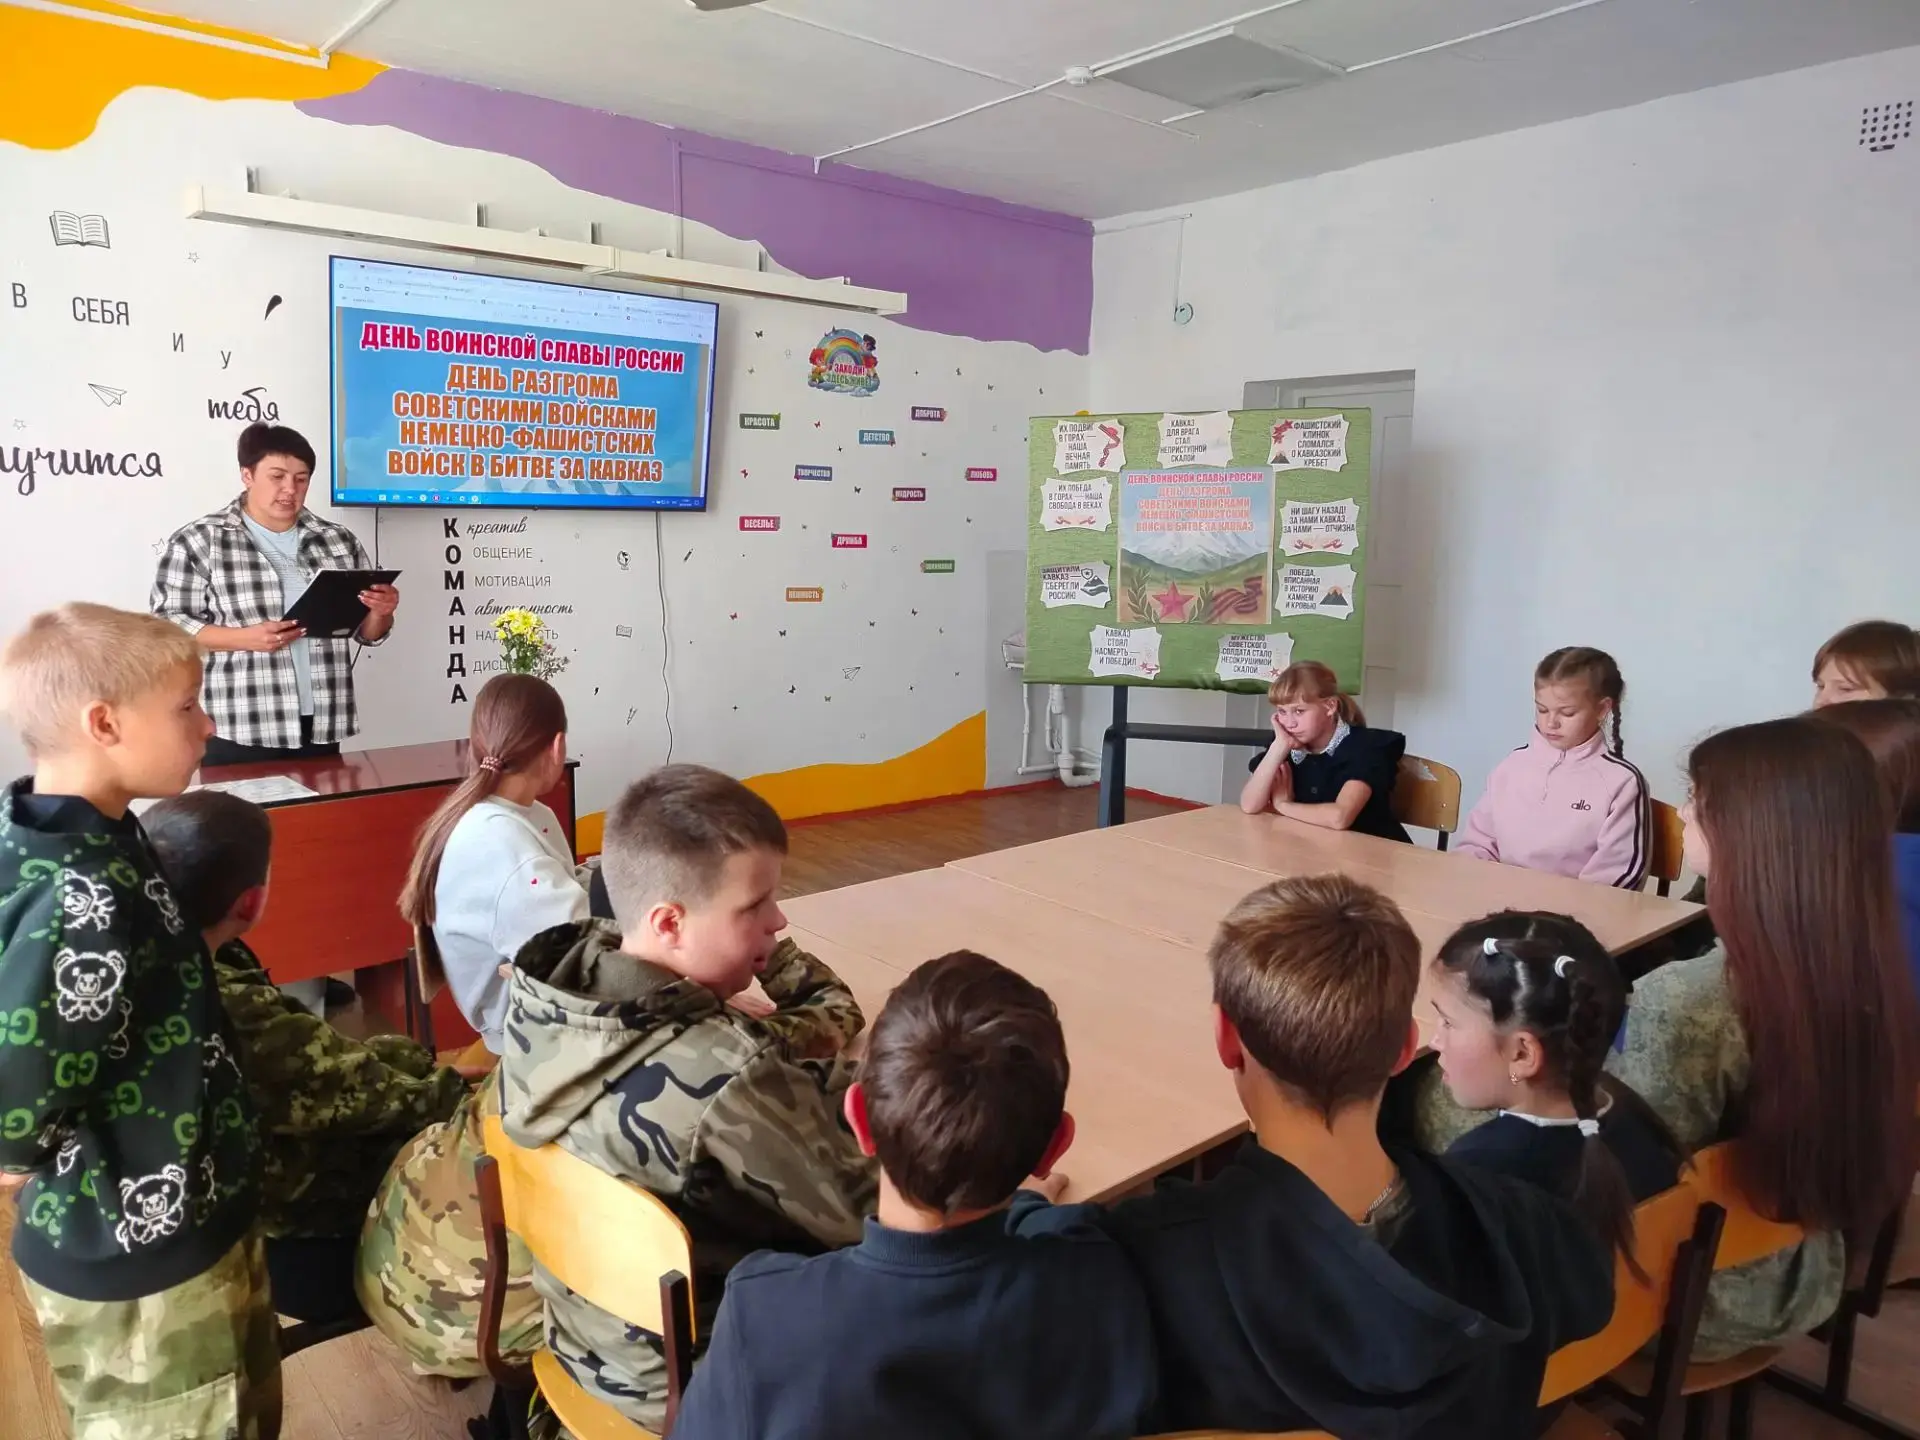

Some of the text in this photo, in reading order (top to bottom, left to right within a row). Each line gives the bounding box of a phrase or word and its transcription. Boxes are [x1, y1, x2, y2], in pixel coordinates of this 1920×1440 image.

[12, 282, 27, 308] В
[72, 297, 130, 326] СЕБЯ
[173, 332, 184, 352] И
[361, 322, 684, 373] ДЕНЬ ВОИНСКОЙ СЛАВЫ РОССИИ
[446, 363, 619, 399] ДЕНЬ РАЗГРОМА
[208, 387, 280, 422] тебя
[393, 391, 657, 431] СОВЕТСКИМИ ВОЙСКАМИ
[915, 409, 941, 418] ДОБРОТА
[744, 417, 775, 427] КРАСОТА
[1170, 419, 1195, 427] КАВКАЗ
[1293, 420, 1341, 430] ФАШИСТСКИЙ
[1059, 423, 1094, 432] ИХ ПОДВИГ
[863, 432, 890, 442] ДЕТСТВО
[1166, 428, 1200, 437] ДЛЯ ВРАГА
[1302, 430, 1330, 439] КЛИНОК
[400, 420, 655, 456] НЕМЕЦКО-ФАШИСТСКИХ
[1064, 434, 1085, 442] ГОРАХ
[1174, 437, 1191, 445] СТАЛ
[1068, 443, 1088, 451] НАША
[1160, 444, 1207, 454] НЕПРИСТУПНОЙ
[1297, 440, 1334, 449] СЛОМАЛСЯ
[1065, 452, 1090, 461] ВЕЧНАЯ
[1297, 448, 1341, 458] КАВКАЗСКИЙ
[1170, 454, 1195, 463] СКАЛОЙ
[1303, 459, 1328, 467] ХРЕБЕТ
[387, 448, 663, 483] ВОЙСК В БИТВЕ ЗА КАВКАЗ
[1065, 462, 1091, 470] ПАМЯТЬ
[1128, 472, 1264, 484] ДЕНЬ ВОИНСКОЙ СЛАВЫ РОССИИ
[1058, 483, 1092, 492] ИХ ПОБЕДА
[1054, 493, 1073, 501] ГОРАХ
[1048, 501, 1076, 510] СВОБОДА
[1083, 501, 1103, 509] ВЕКАХ
[1301, 506, 1320, 515] ШАГУ
[1321, 506, 1346, 514] НАЗАД!
[744, 518, 774, 529] ВЕСЕЛЬЕ
[1289, 516, 1298, 524] ЗА
[1299, 516, 1318, 524] НАМИ
[466, 516, 528, 540] креатив
[1283, 525, 1291, 533] ЗА
[1292, 525, 1312, 533] НАМИ
[1325, 524, 1355, 533] ОТЧИЗНА
[473, 546, 533, 560] ОБЩЕНИЕ
[1042, 566, 1080, 574] ЗАЩИТИЛИ
[474, 575, 551, 589] МОТИВАЦИЯ
[1045, 581, 1080, 590] СБЕРЕГЛИ
[1289, 585, 1319, 593] ИСТОРИЮ
[1048, 591, 1076, 600] РОССИЮ
[1287, 593, 1314, 601] КАМНЕМ
[1291, 602, 1317, 610] КРОВЬЮ
[1105, 629, 1131, 637] КАВКАЗ
[1107, 638, 1128, 647] СТОЯЛ
[1228, 641, 1267, 649] СОВЕТСКОГО
[1094, 647, 1129, 656] НАСМЕРТЬ
[1222, 648, 1272, 658] СОЛДАТА СТАЛО
[1105, 657, 1137, 666] ПОБЕДИЛ
[1233, 665, 1258, 674] СКАЛОЙ
